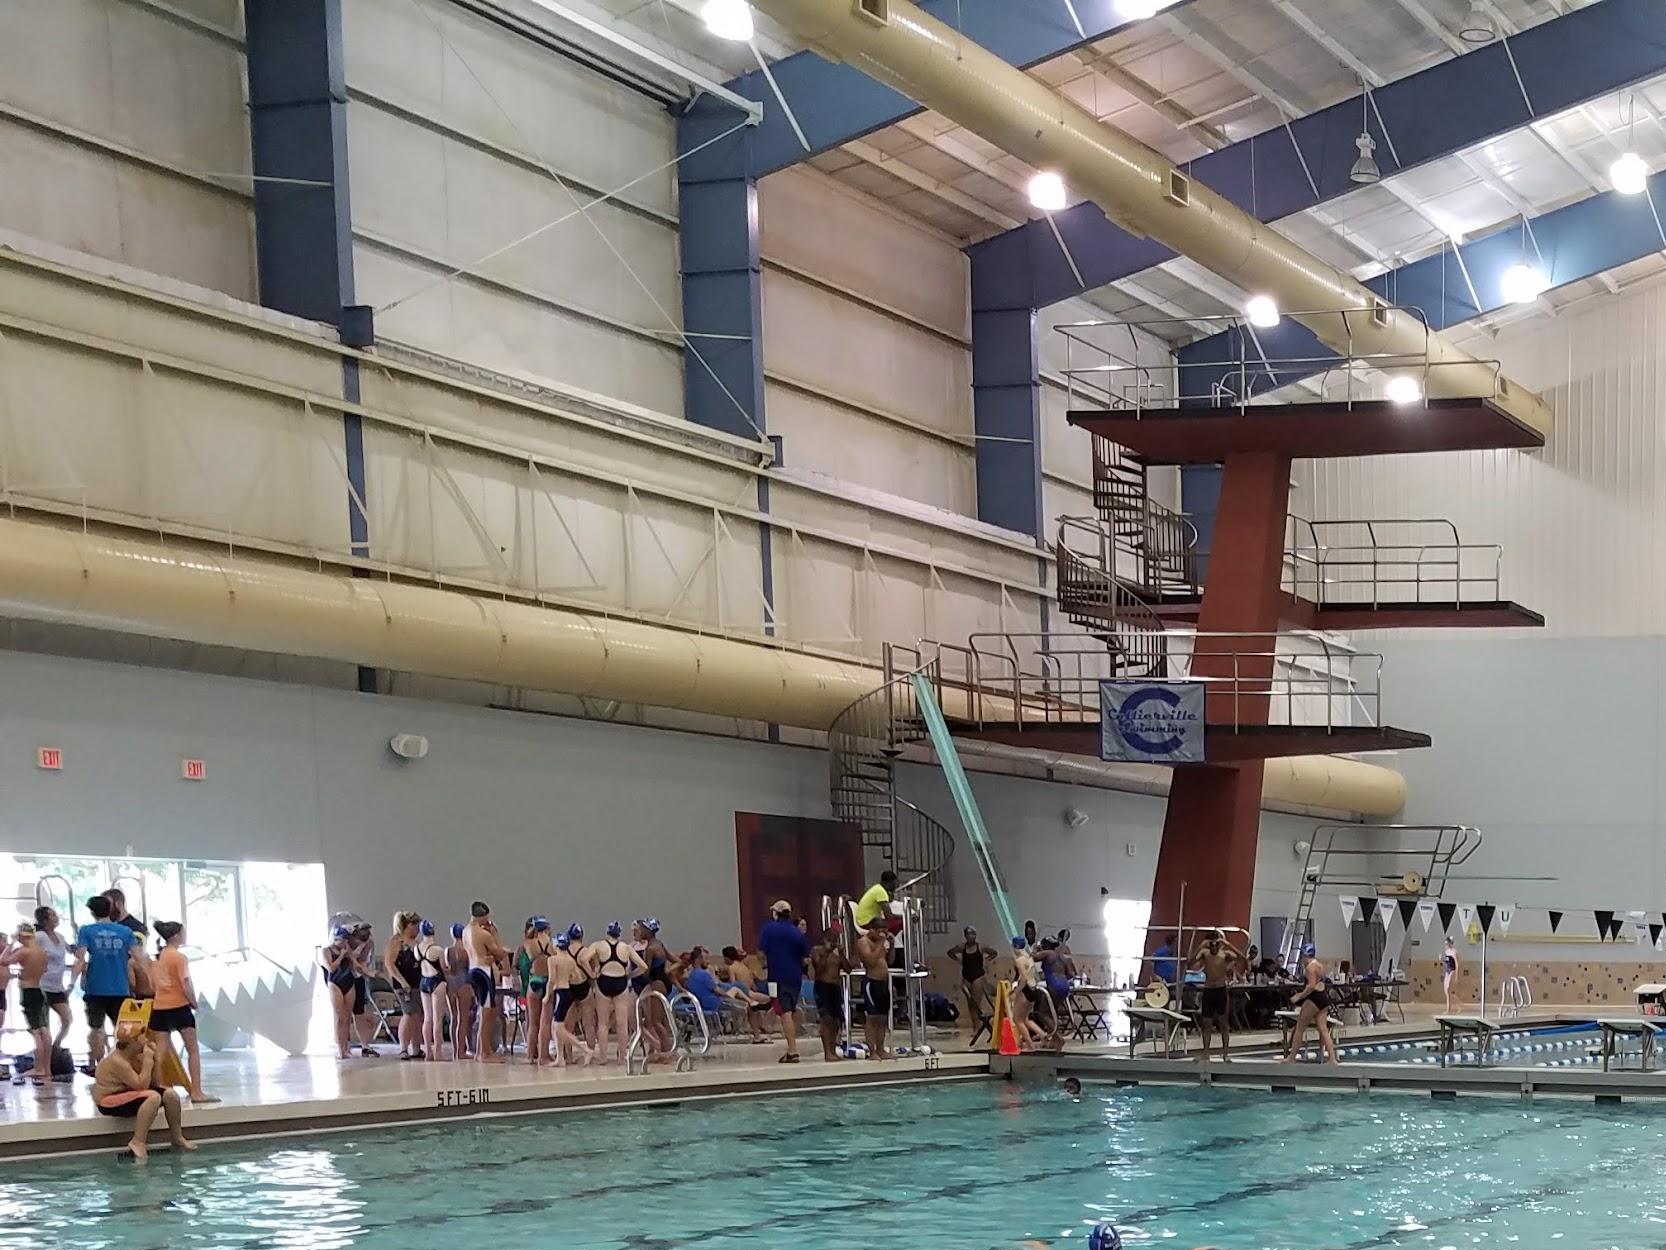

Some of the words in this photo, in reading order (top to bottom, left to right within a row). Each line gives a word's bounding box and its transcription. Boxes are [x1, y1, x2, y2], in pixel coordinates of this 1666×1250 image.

[1108, 708, 1198, 721] Collierville
[43, 750, 60, 766] EXIT
[187, 762, 202, 776] EXIT
[1502, 912, 1510, 922] U
